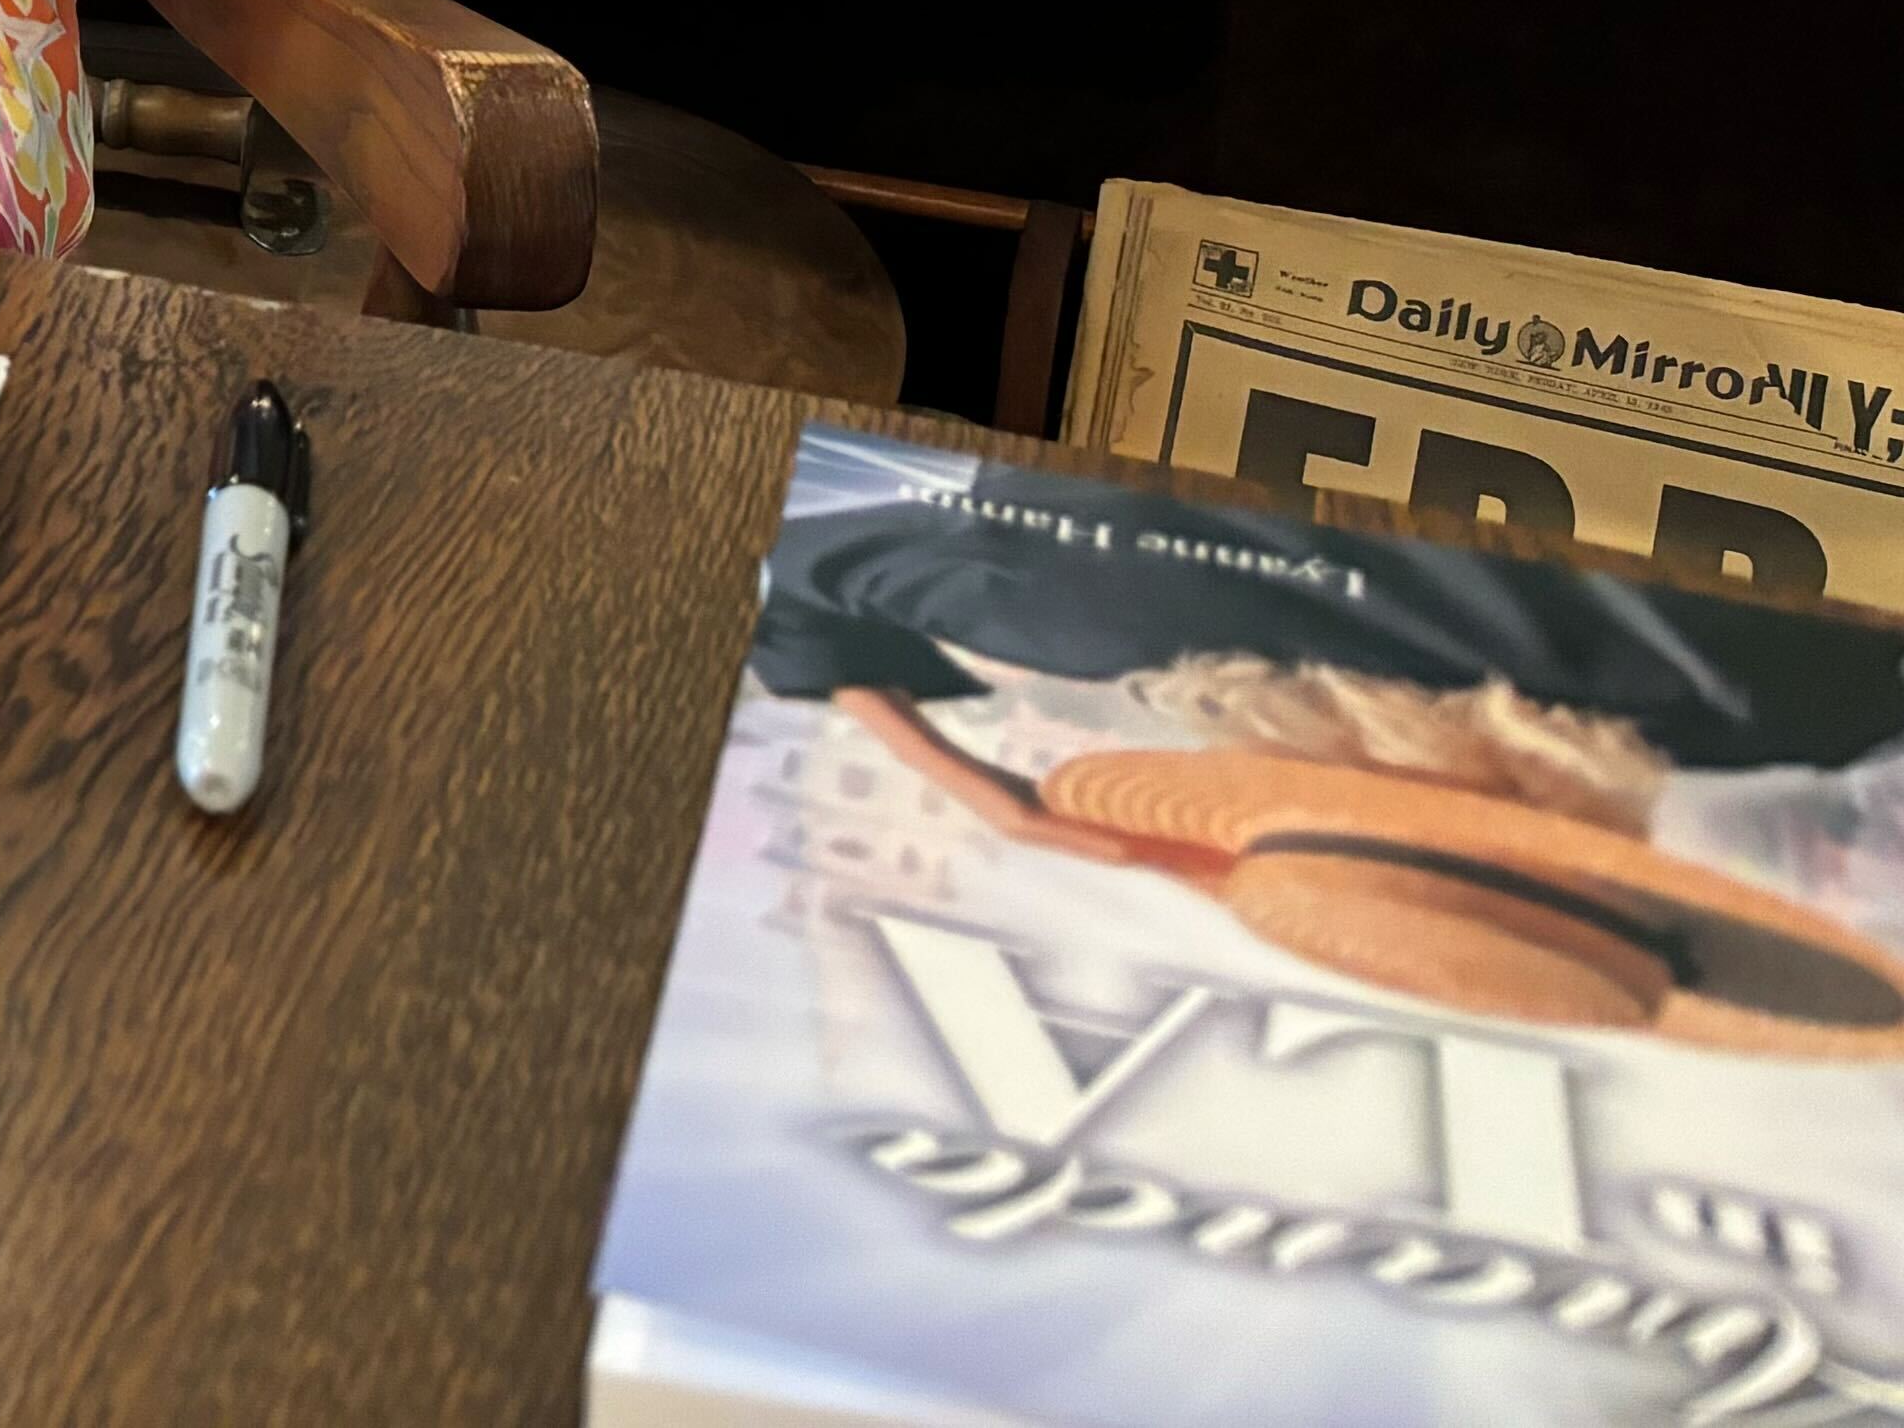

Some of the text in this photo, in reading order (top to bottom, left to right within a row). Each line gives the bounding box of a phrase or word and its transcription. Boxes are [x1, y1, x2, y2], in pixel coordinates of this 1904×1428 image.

[1347, 278, 1511, 356] Daily
[1571, 327, 1768, 406] Mirror
[854, 906, 1594, 1256] LA
